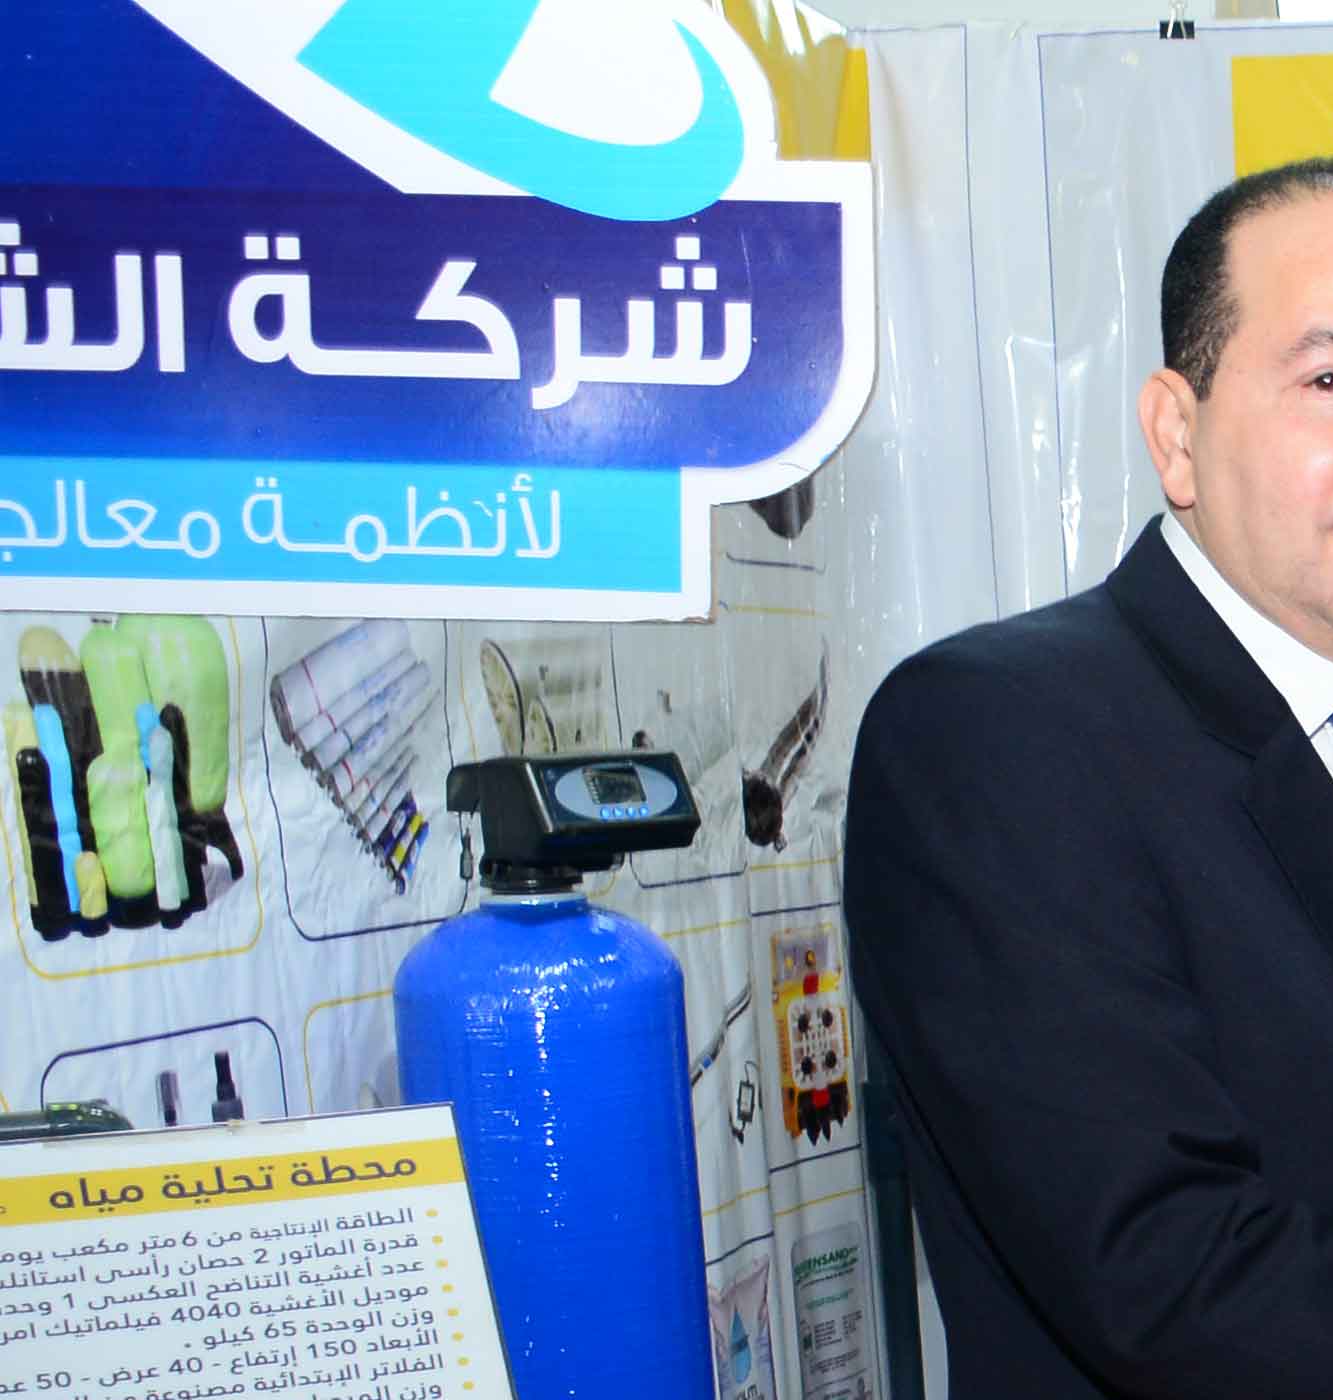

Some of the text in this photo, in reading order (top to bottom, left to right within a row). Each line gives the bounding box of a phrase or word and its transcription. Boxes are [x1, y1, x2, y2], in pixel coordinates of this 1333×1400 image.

[228, 234, 755, 411] شركة
[243, 473, 562, 563] لأنظمة
[49, 1156, 417, 1213] محطة تحلية مياه
[250, 1218, 330, 1241] الإنتاجية
[336, 1207, 414, 1231] الطاقة
[52, 1237, 130, 1260] مكعب
[207, 1230, 243, 1248] من
[363, 1233, 419, 1255] قدرة
[179, 1253, 244, 1276] حصان
[253, 1248, 270, 1265] 2
[279, 1239, 355, 1266] الماتور
[96, 1254, 170, 1285] رأسى
[299, 1257, 373, 1286] أغشية
[382, 1260, 425, 1276] عدد
[88, 1280, 197, 1311] العكسى
[206, 1270, 290, 1301] التناضح
[353, 1284, 429, 1308] موديل
[63, 1293, 75, 1309] 1
[171, 1301, 241, 1324] 4040
[250, 1289, 345, 1317] الأغشية
[46, 1312, 161, 1338] فيلماتيك
[203, 1307, 435, 1350] وزن الوحدة 65 كيلو
[307, 1339, 357, 1359] 150
[366, 1328, 439, 1353] الأبعاد
[169, 1357, 204, 1375] 40
[230, 1346, 298, 1375] إرتفاع
[370, 1352, 444, 1382] الفلاتر
[36, 1371, 72, 1390] 50
[99, 1366, 160, 1388] عرض
[254, 1363, 361, 1393] الإبتدائية
